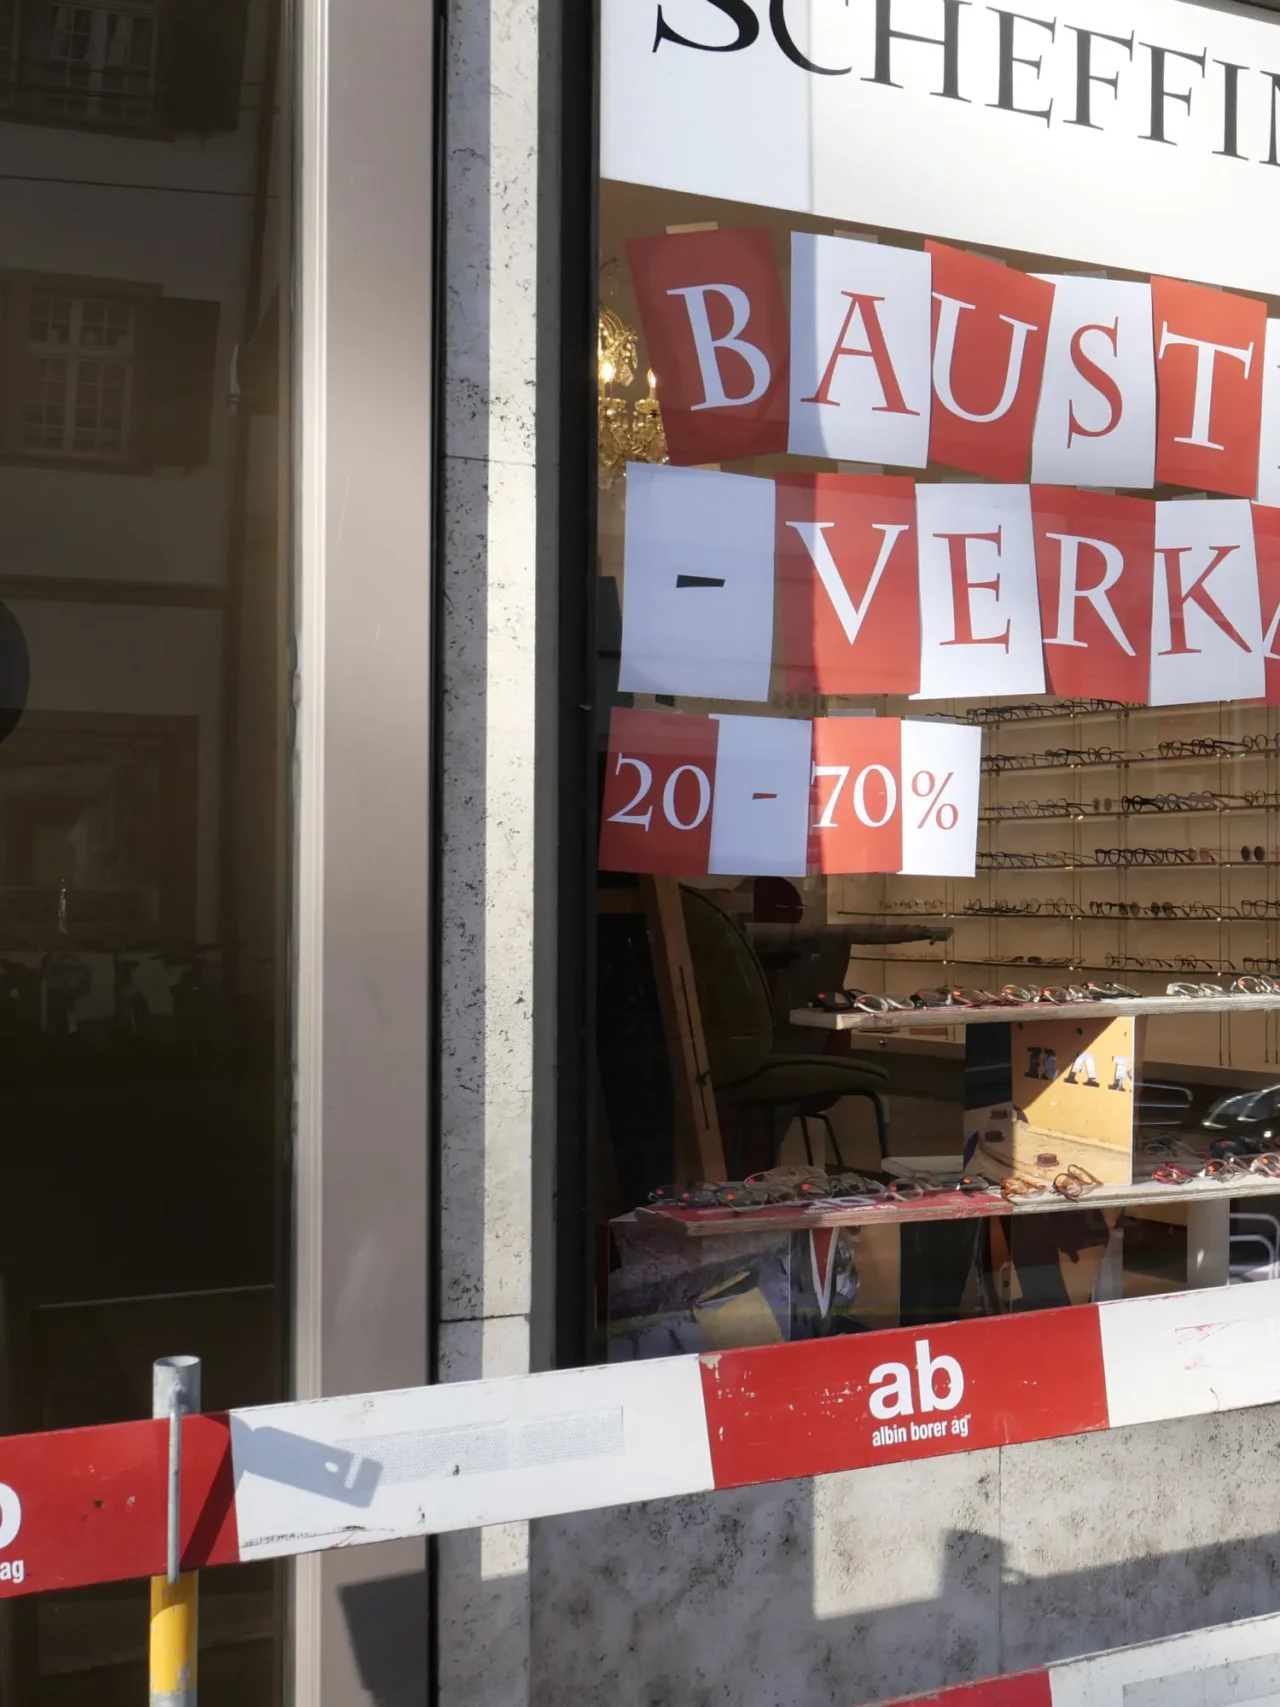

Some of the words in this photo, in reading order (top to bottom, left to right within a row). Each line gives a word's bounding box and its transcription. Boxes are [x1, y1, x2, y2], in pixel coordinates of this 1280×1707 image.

[868, 1339, 965, 1420] ab
[872, 1424, 908, 1447] albin
[910, 1421, 948, 1441] borer
[951, 1416, 969, 1437] ag
[0, 1559, 24, 1584] ag
